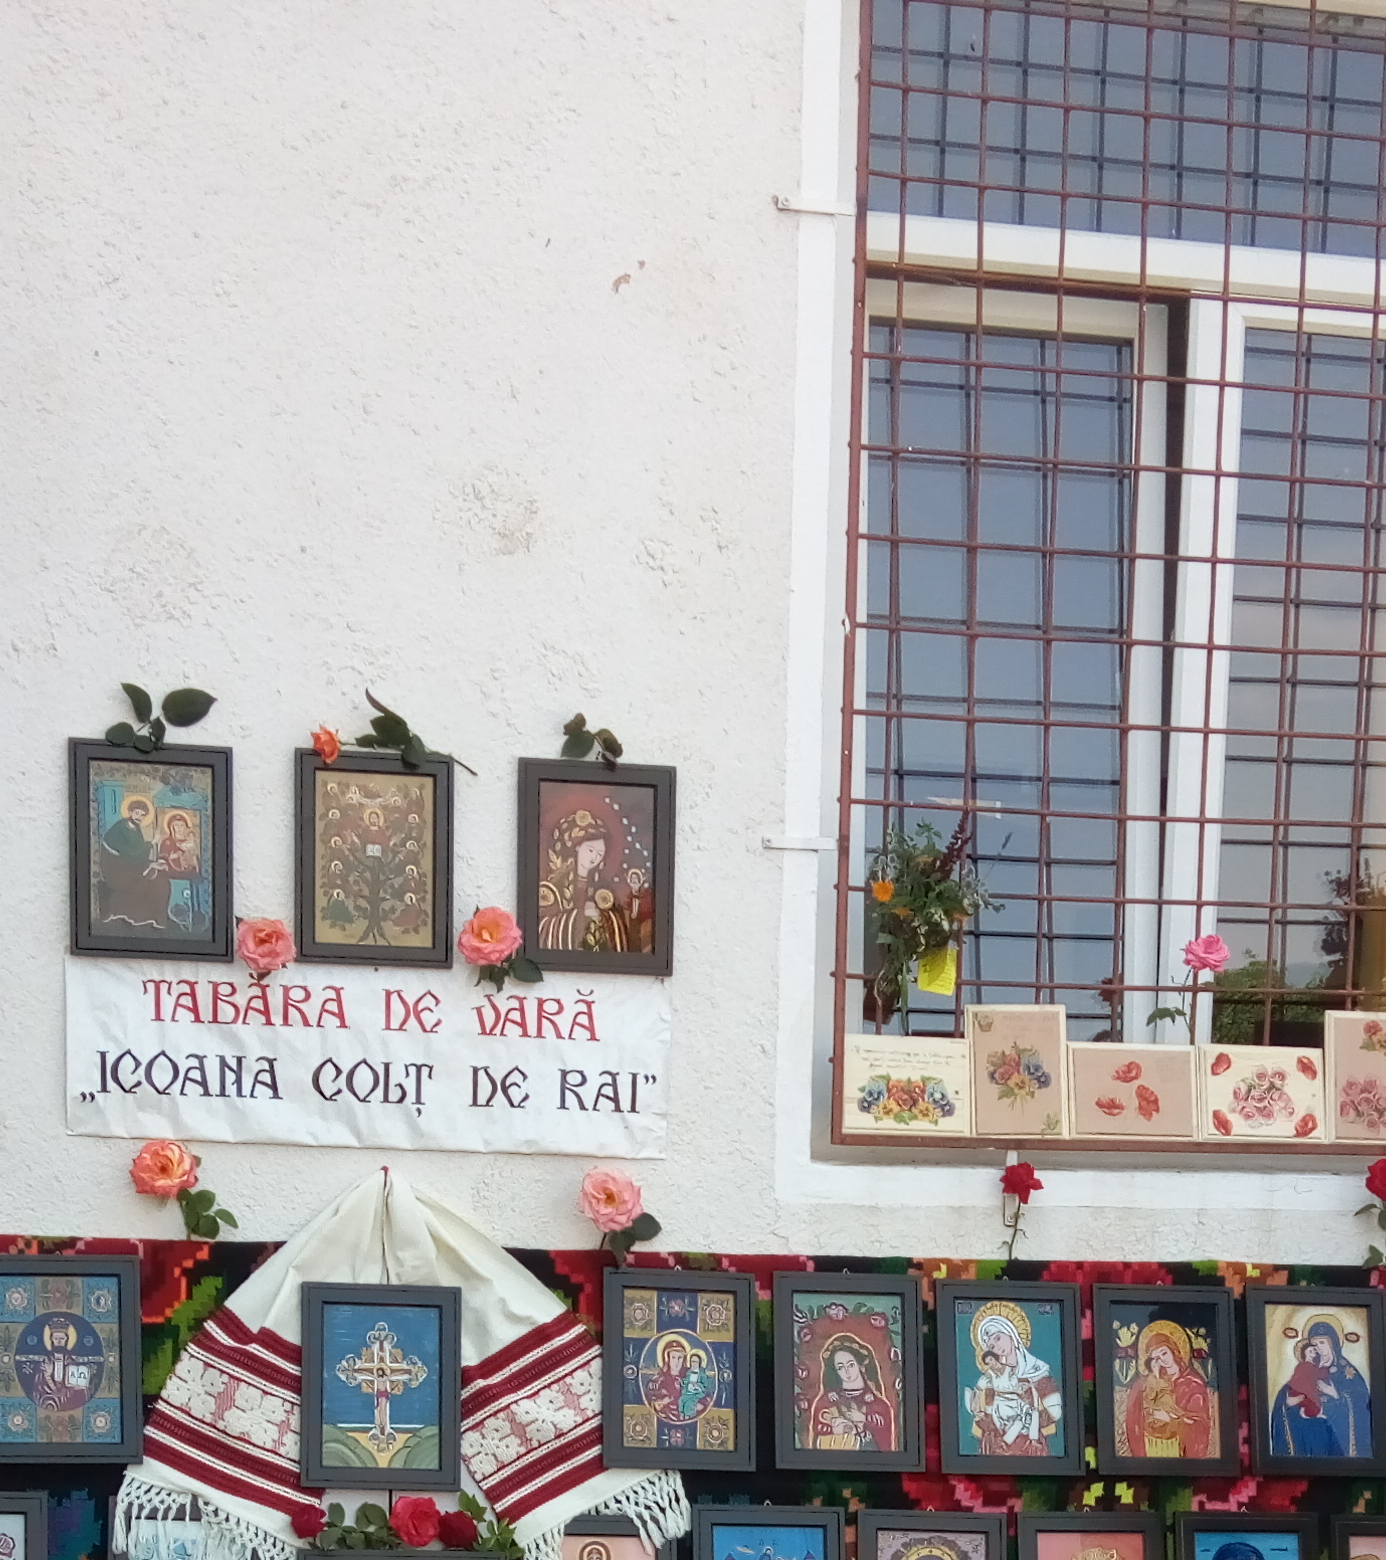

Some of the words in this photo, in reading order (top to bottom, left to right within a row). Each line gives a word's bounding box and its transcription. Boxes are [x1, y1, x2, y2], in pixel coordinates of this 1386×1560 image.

[381, 988, 443, 1034] DE
[472, 988, 601, 1042] VARĂ
[311, 1056, 435, 1118] COLȚ
[468, 1065, 530, 1110] DE
[556, 1068, 657, 1114] RAI”
